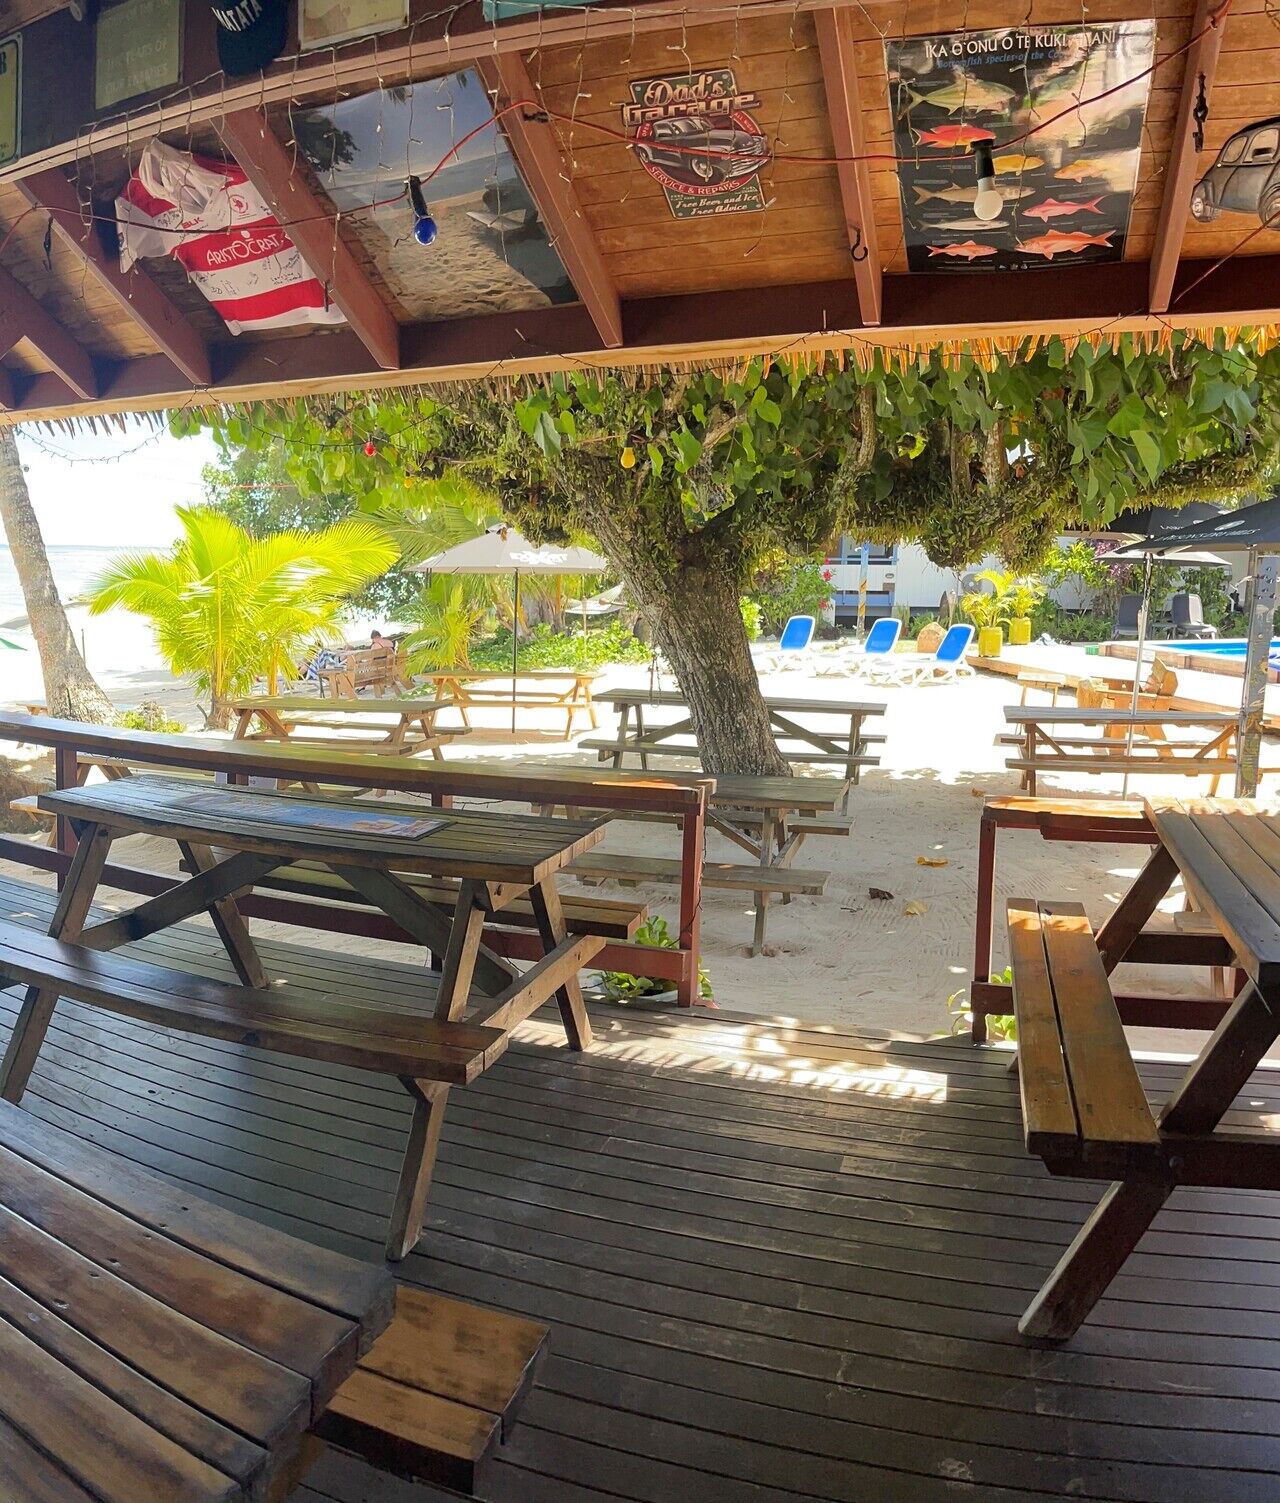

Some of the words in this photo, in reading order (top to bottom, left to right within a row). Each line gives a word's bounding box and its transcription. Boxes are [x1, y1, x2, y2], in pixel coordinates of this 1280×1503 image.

[925, 44, 947, 59] IKA
[1001, 36, 1014, 50] O
[1016, 34, 1031, 50] TE
[1035, 33, 1067, 49] KUKI
[644, 74, 727, 107] Dad's
[623, 94, 760, 126] Garage
[650, 166, 686, 192] SERVICE
[697, 180, 740, 195] REPAIRS
[676, 200, 698, 209] Free
[699, 197, 721, 206] Beer
[724, 194, 742, 204] and
[743, 193, 758, 201] Ice
[691, 208, 713, 216] Free
[181, 217, 204, 229] BLK
